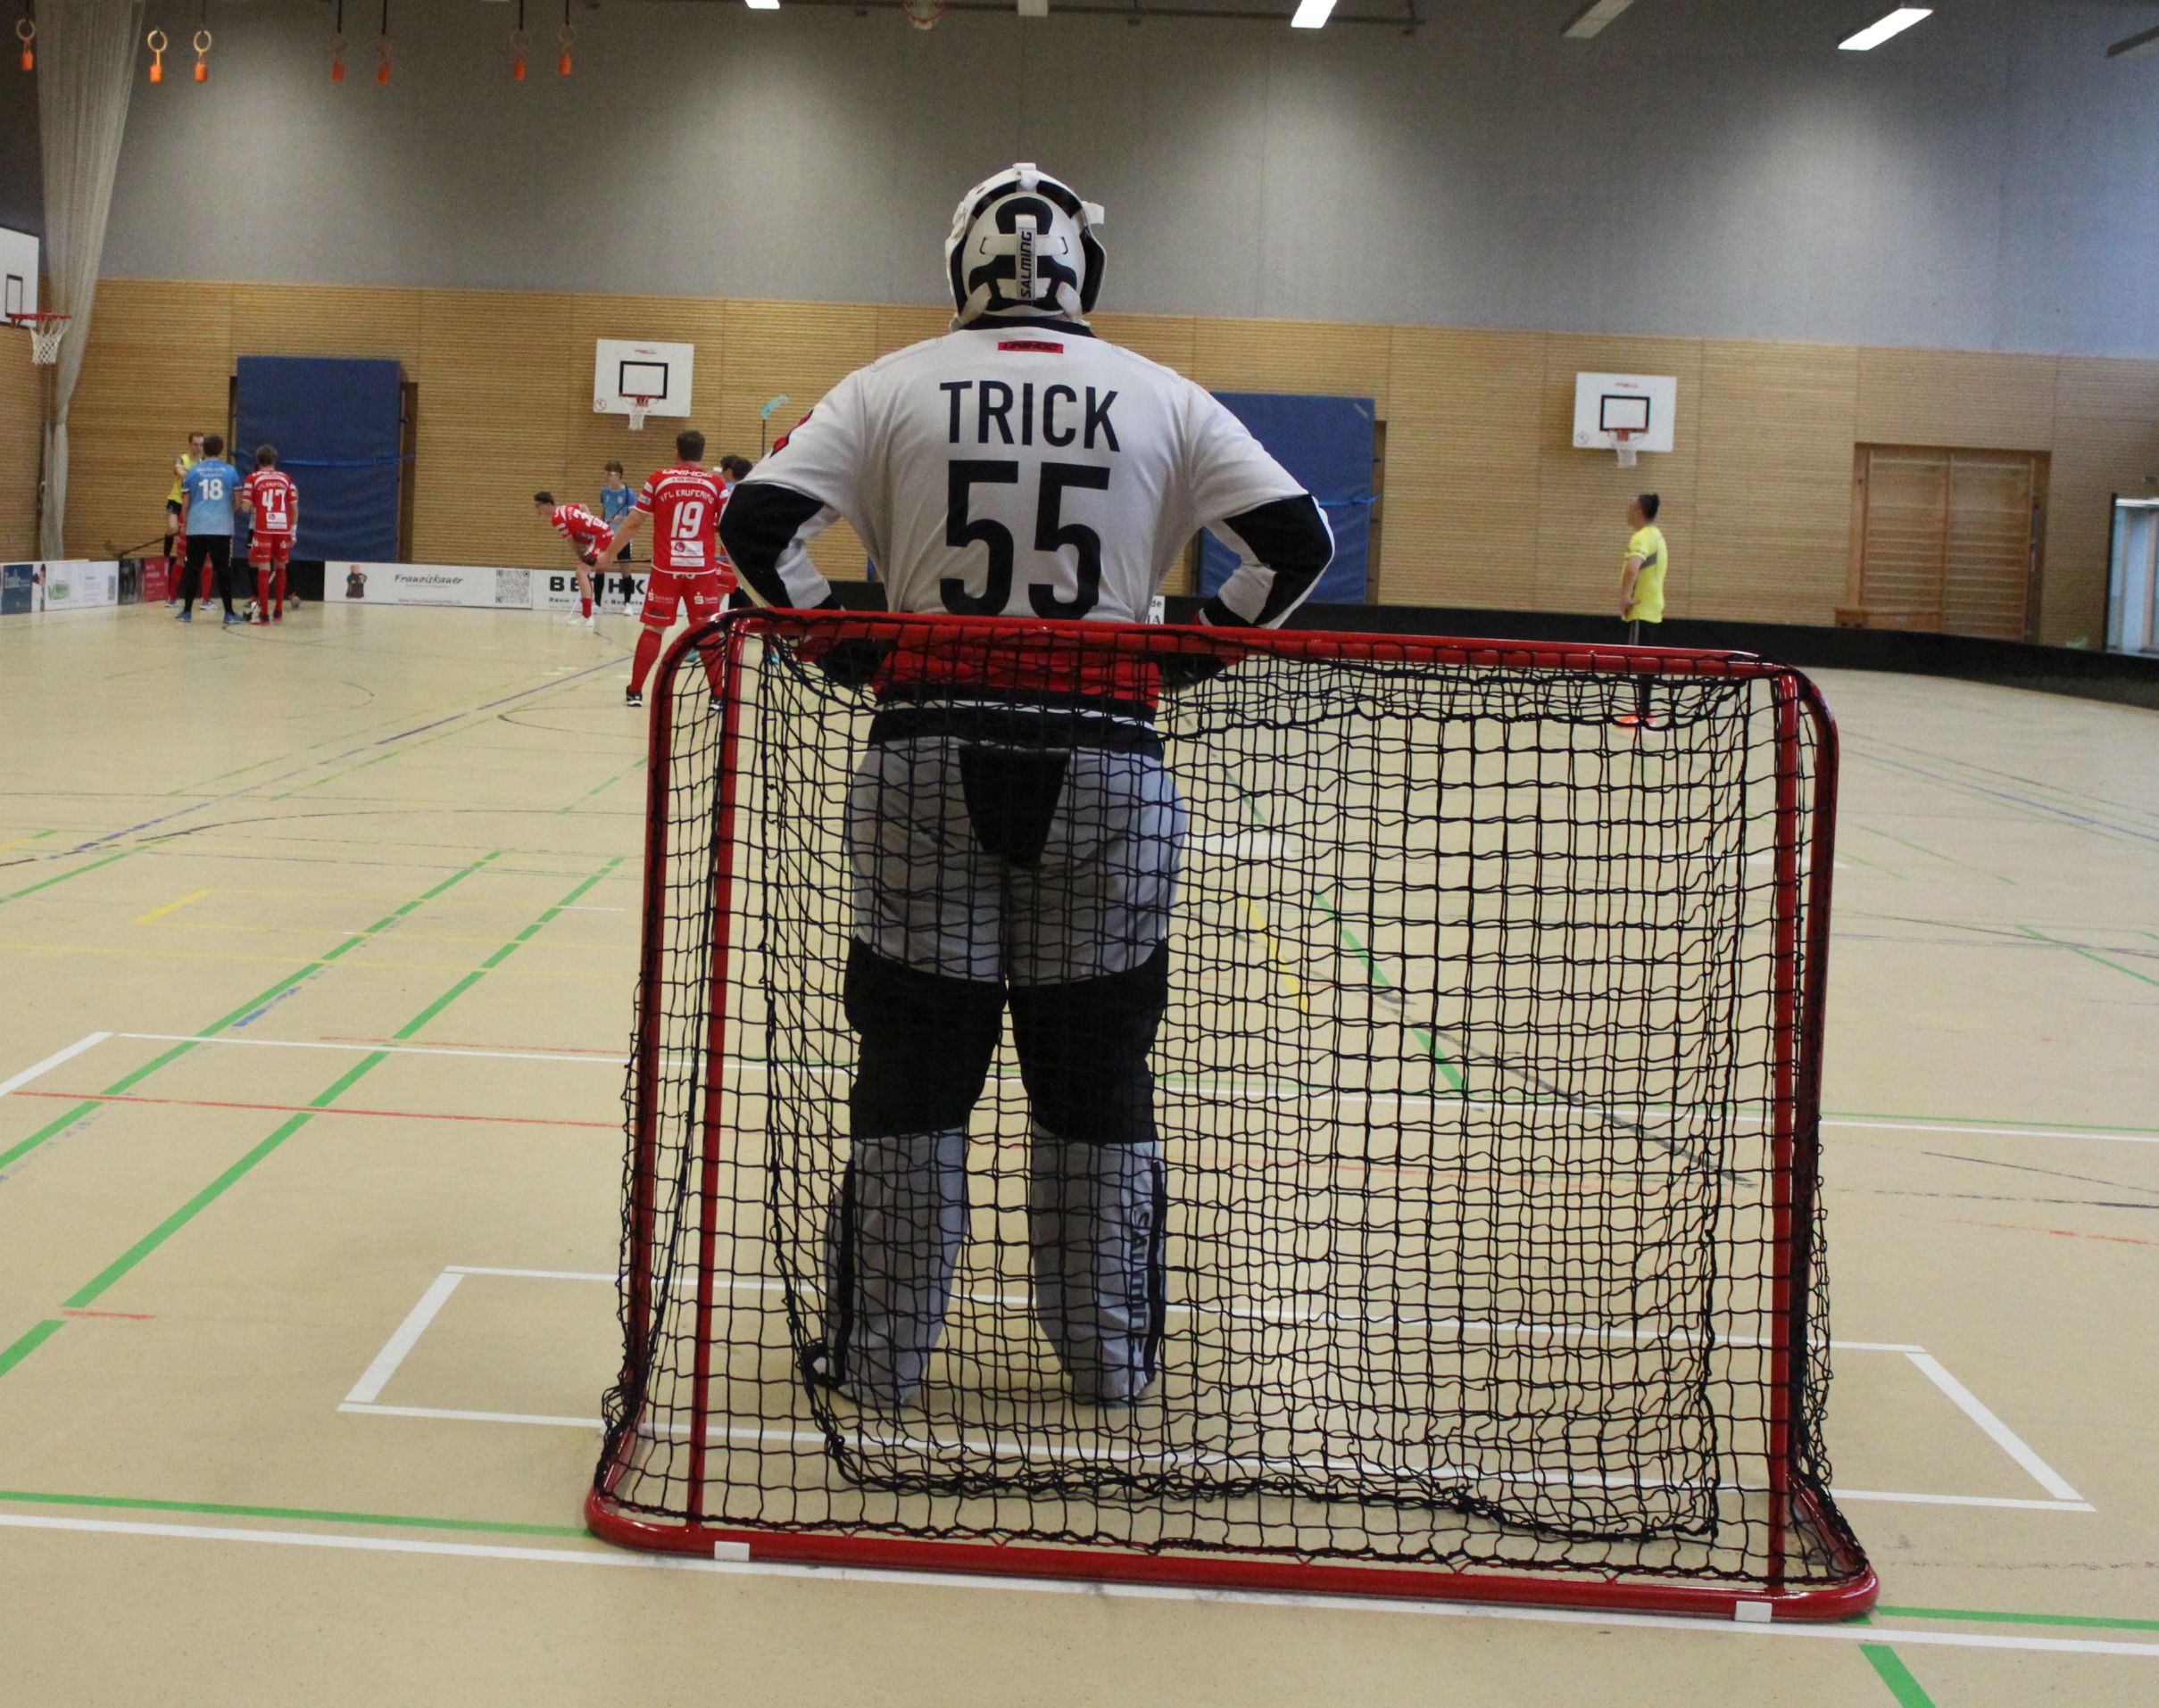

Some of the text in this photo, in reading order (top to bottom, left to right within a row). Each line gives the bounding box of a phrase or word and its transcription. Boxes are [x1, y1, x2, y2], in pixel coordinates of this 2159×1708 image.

[1019, 229, 1033, 299] SALMING
[939, 380, 1120, 452] TRICK
[198, 478, 223, 501] 18
[262, 489, 286, 511] 47
[670, 501, 705, 539] 19
[939, 460, 1111, 619] 55
